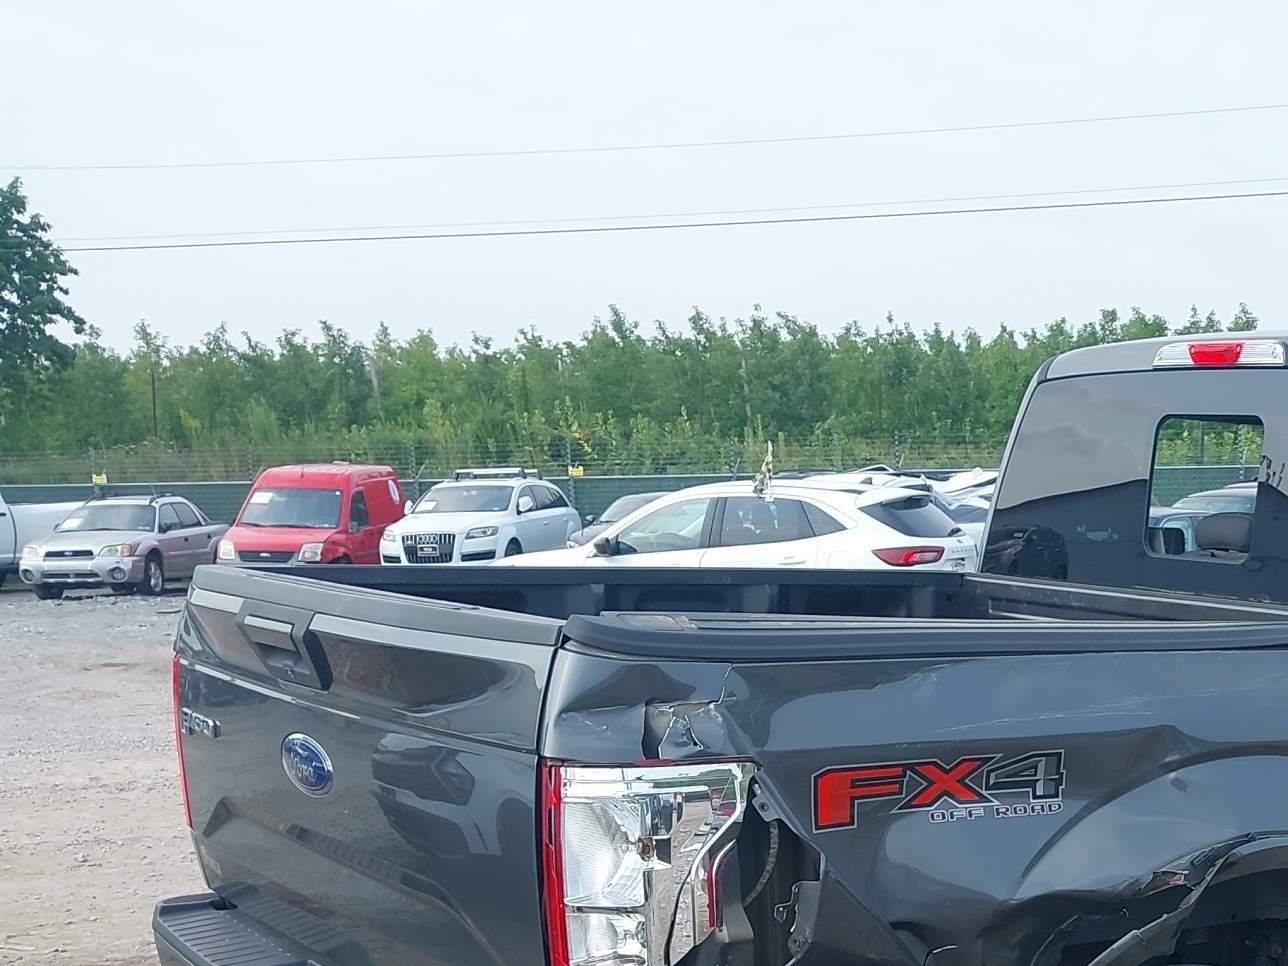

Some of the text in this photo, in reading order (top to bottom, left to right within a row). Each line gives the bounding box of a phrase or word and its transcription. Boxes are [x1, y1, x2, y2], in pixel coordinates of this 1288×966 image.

[811, 749, 1066, 834] FX4
[928, 801, 1064, 824] OFF ROAD
